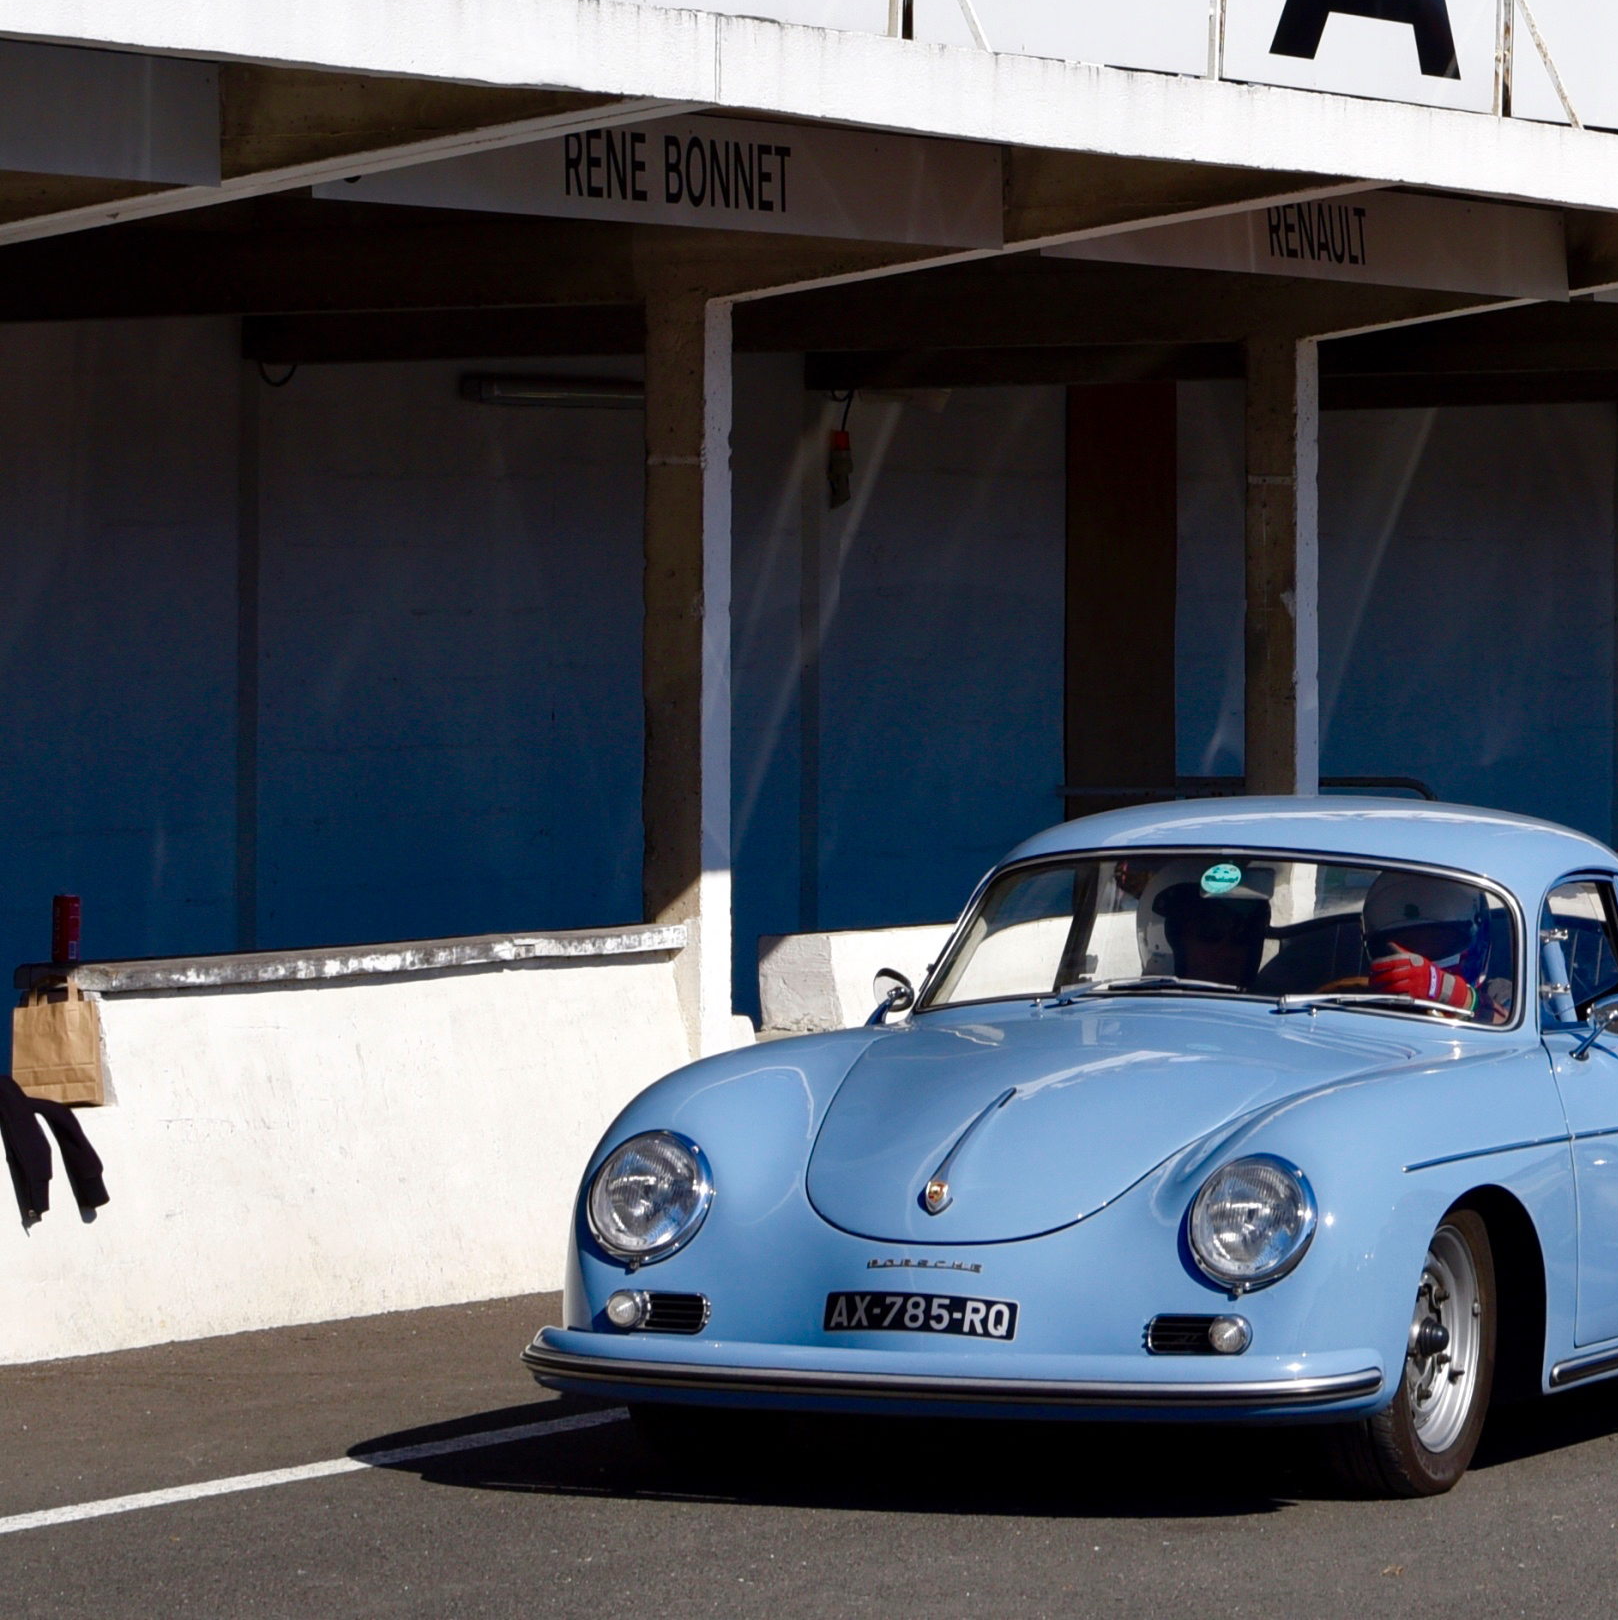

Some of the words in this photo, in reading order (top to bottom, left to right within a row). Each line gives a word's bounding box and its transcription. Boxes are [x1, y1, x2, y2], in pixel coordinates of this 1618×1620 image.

[664, 134, 792, 214] BONNET
[1267, 203, 1366, 266] RENAULT
[866, 1258, 983, 1273] PORSCHE
[829, 1295, 1012, 1337] AX-785-RQ
